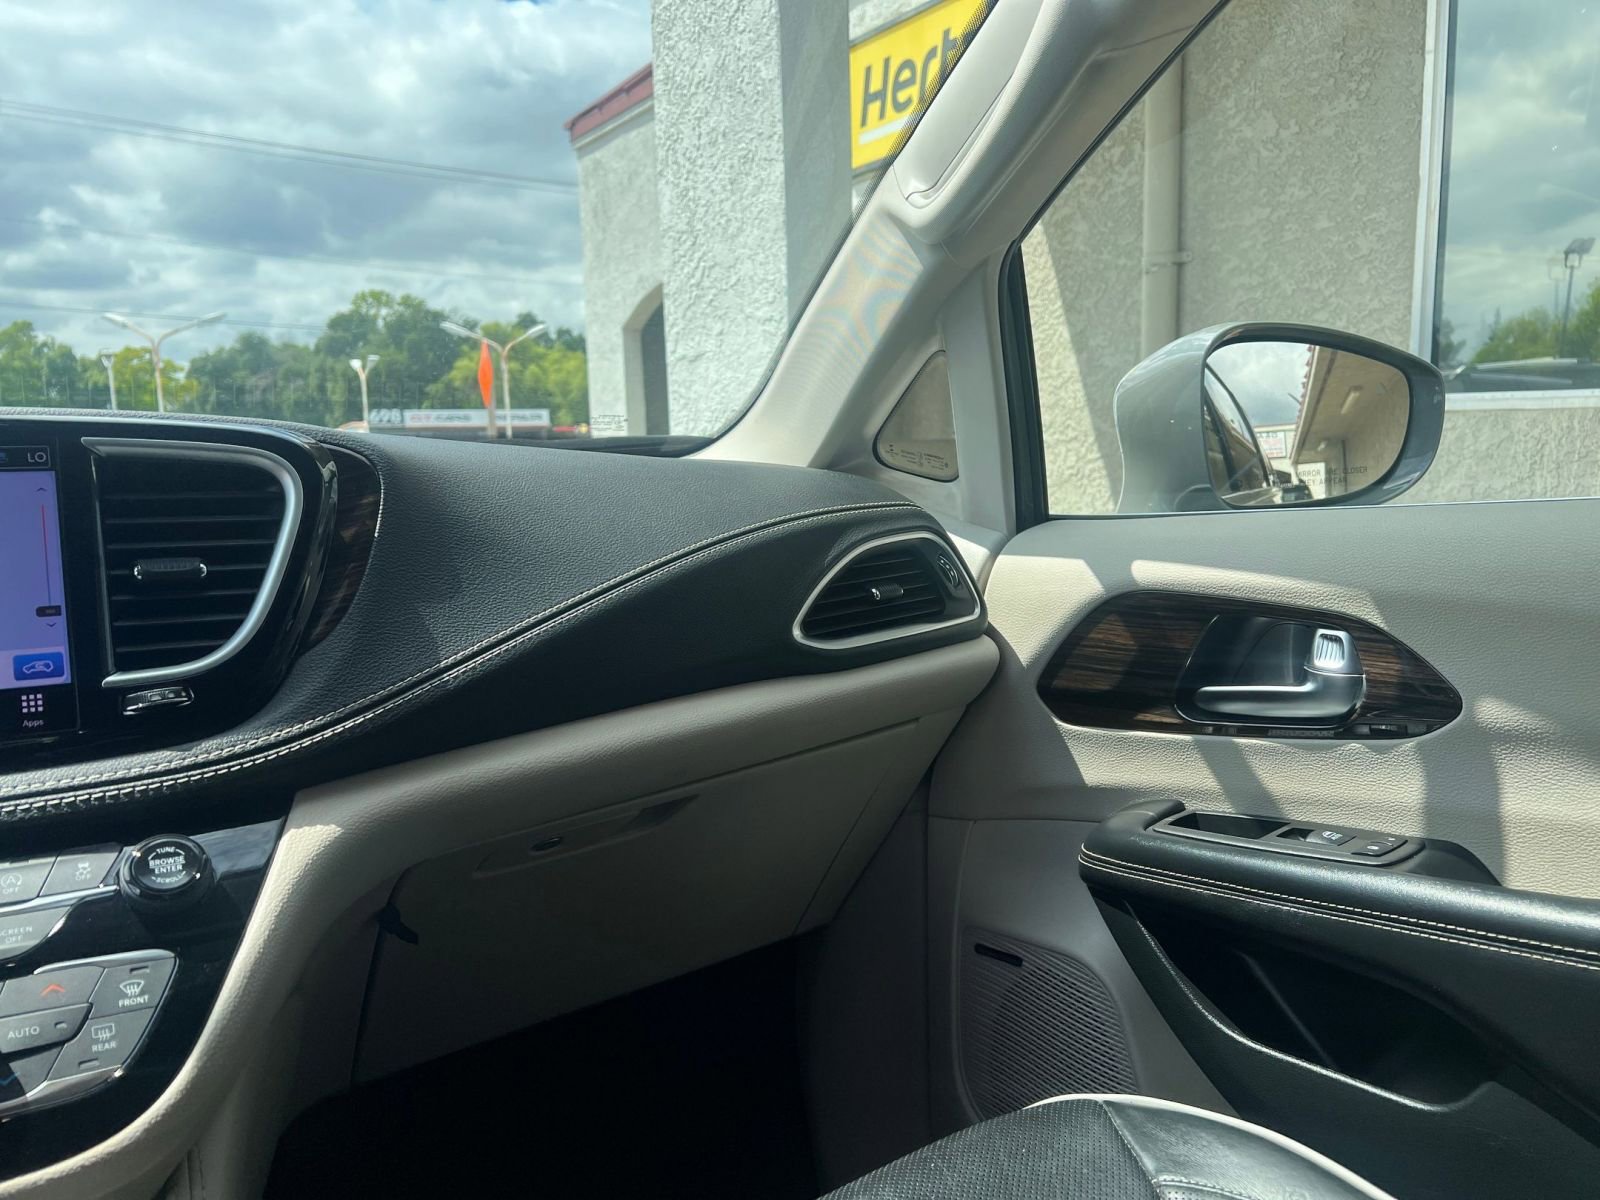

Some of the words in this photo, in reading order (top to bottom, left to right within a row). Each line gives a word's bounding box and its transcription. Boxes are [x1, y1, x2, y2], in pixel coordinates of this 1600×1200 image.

[860, 27, 964, 128] Hert
[27, 452, 47, 463] LO
[22, 719, 44, 728] Apps
[156, 846, 175, 854] TUNE
[149, 855, 185, 867] BROWSE
[155, 864, 183, 874] ENTER
[75, 873, 91, 881] OFF
[2, 886, 20, 895] OFF
[5, 934, 24, 944] OFF
[118, 995, 149, 1008] FRONT
[7, 1026, 40, 1040] AUTO
[91, 1041, 118, 1053] REAR
